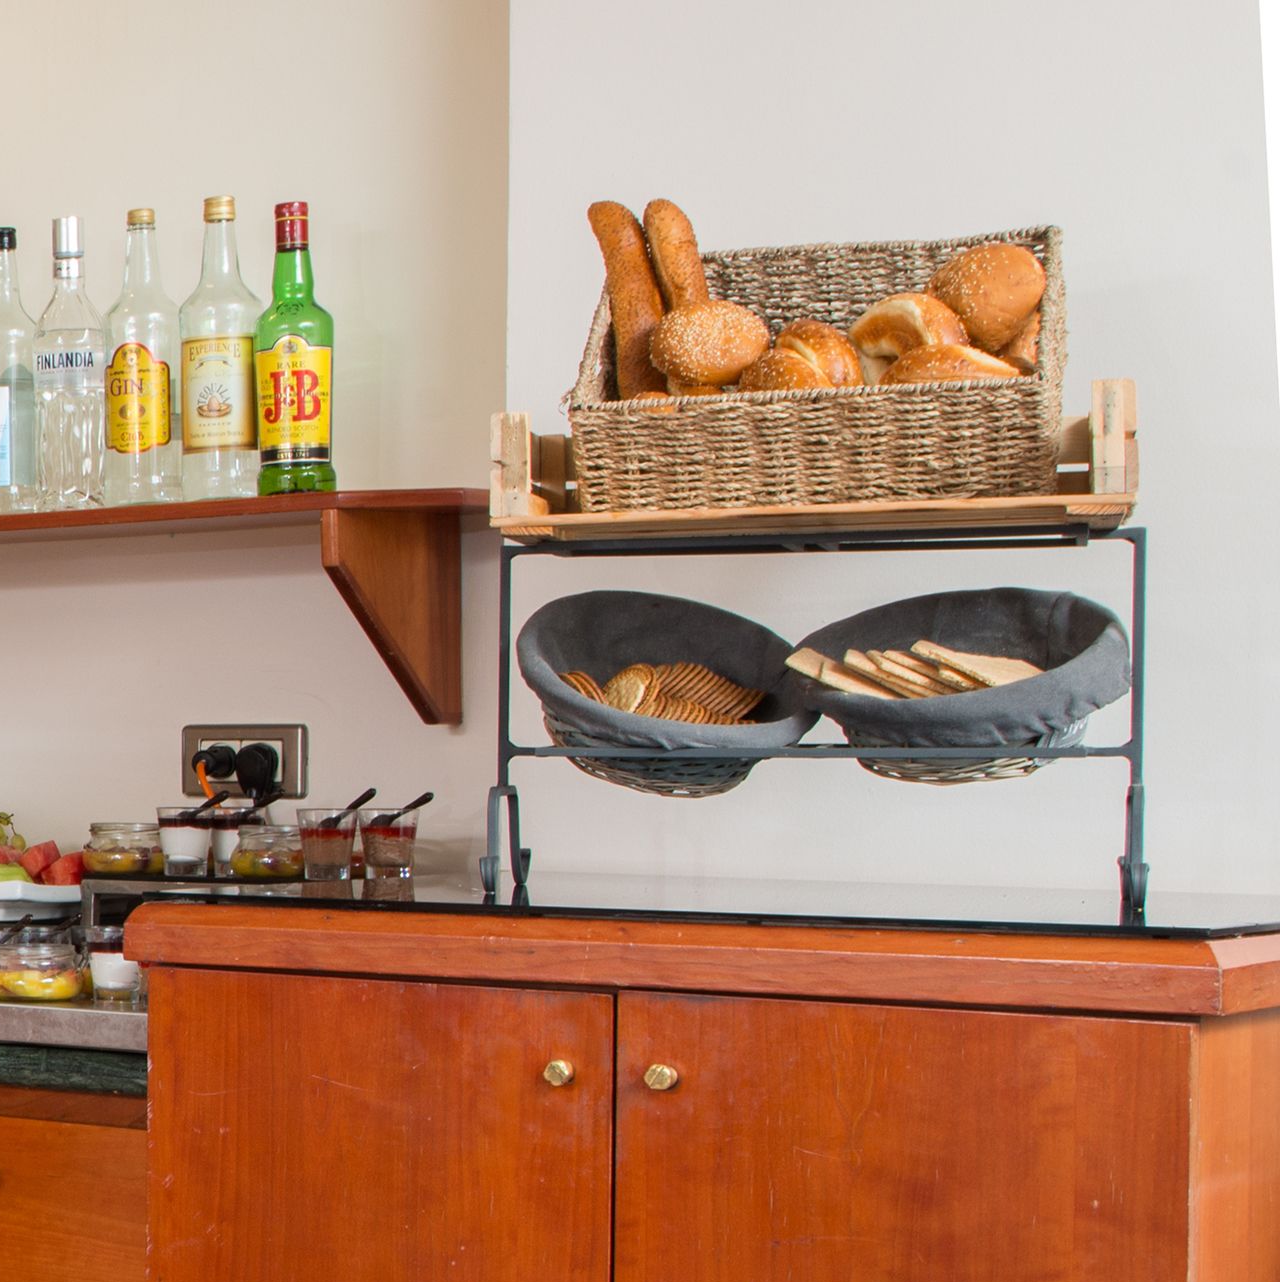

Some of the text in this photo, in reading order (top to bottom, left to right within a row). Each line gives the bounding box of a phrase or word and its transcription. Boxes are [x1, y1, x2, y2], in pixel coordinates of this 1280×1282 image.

[37, 352, 94, 370] FINLANDIA
[189, 343, 241, 361] EXPERIENCE
[277, 361, 305, 369] RARE
[110, 378, 144, 396] GIN
